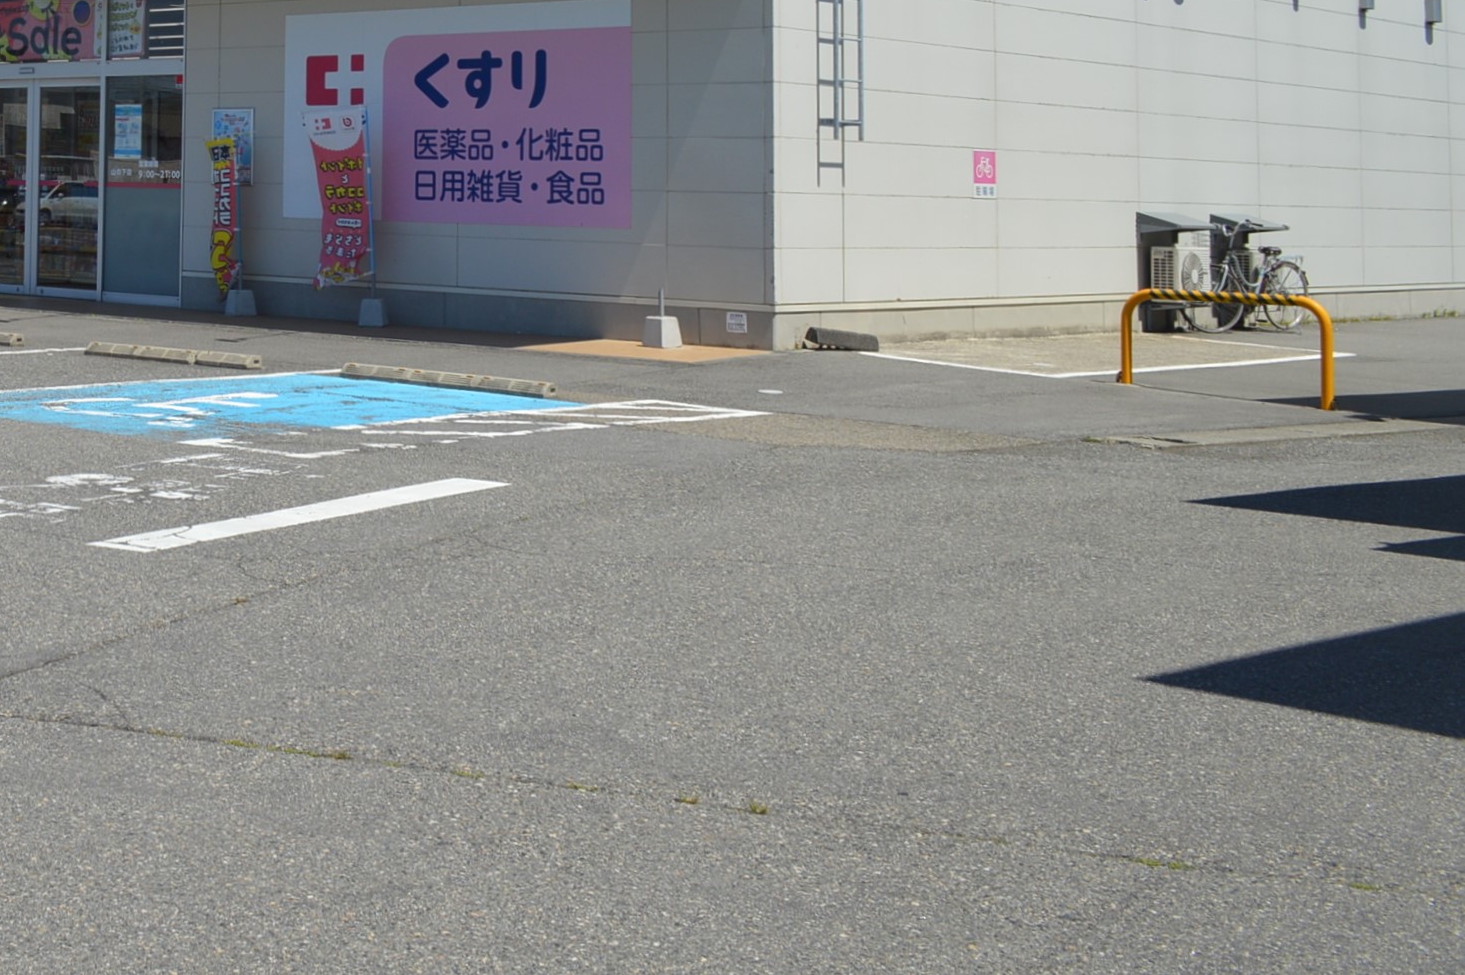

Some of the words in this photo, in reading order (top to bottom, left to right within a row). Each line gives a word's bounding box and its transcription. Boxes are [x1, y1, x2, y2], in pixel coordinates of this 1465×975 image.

[6, 13, 82, 56] Sale
[414, 49, 547, 109] くすり
[414, 127, 604, 162] 医薬品・化粧品
[414, 169, 605, 205] 日用雑貨・食品
